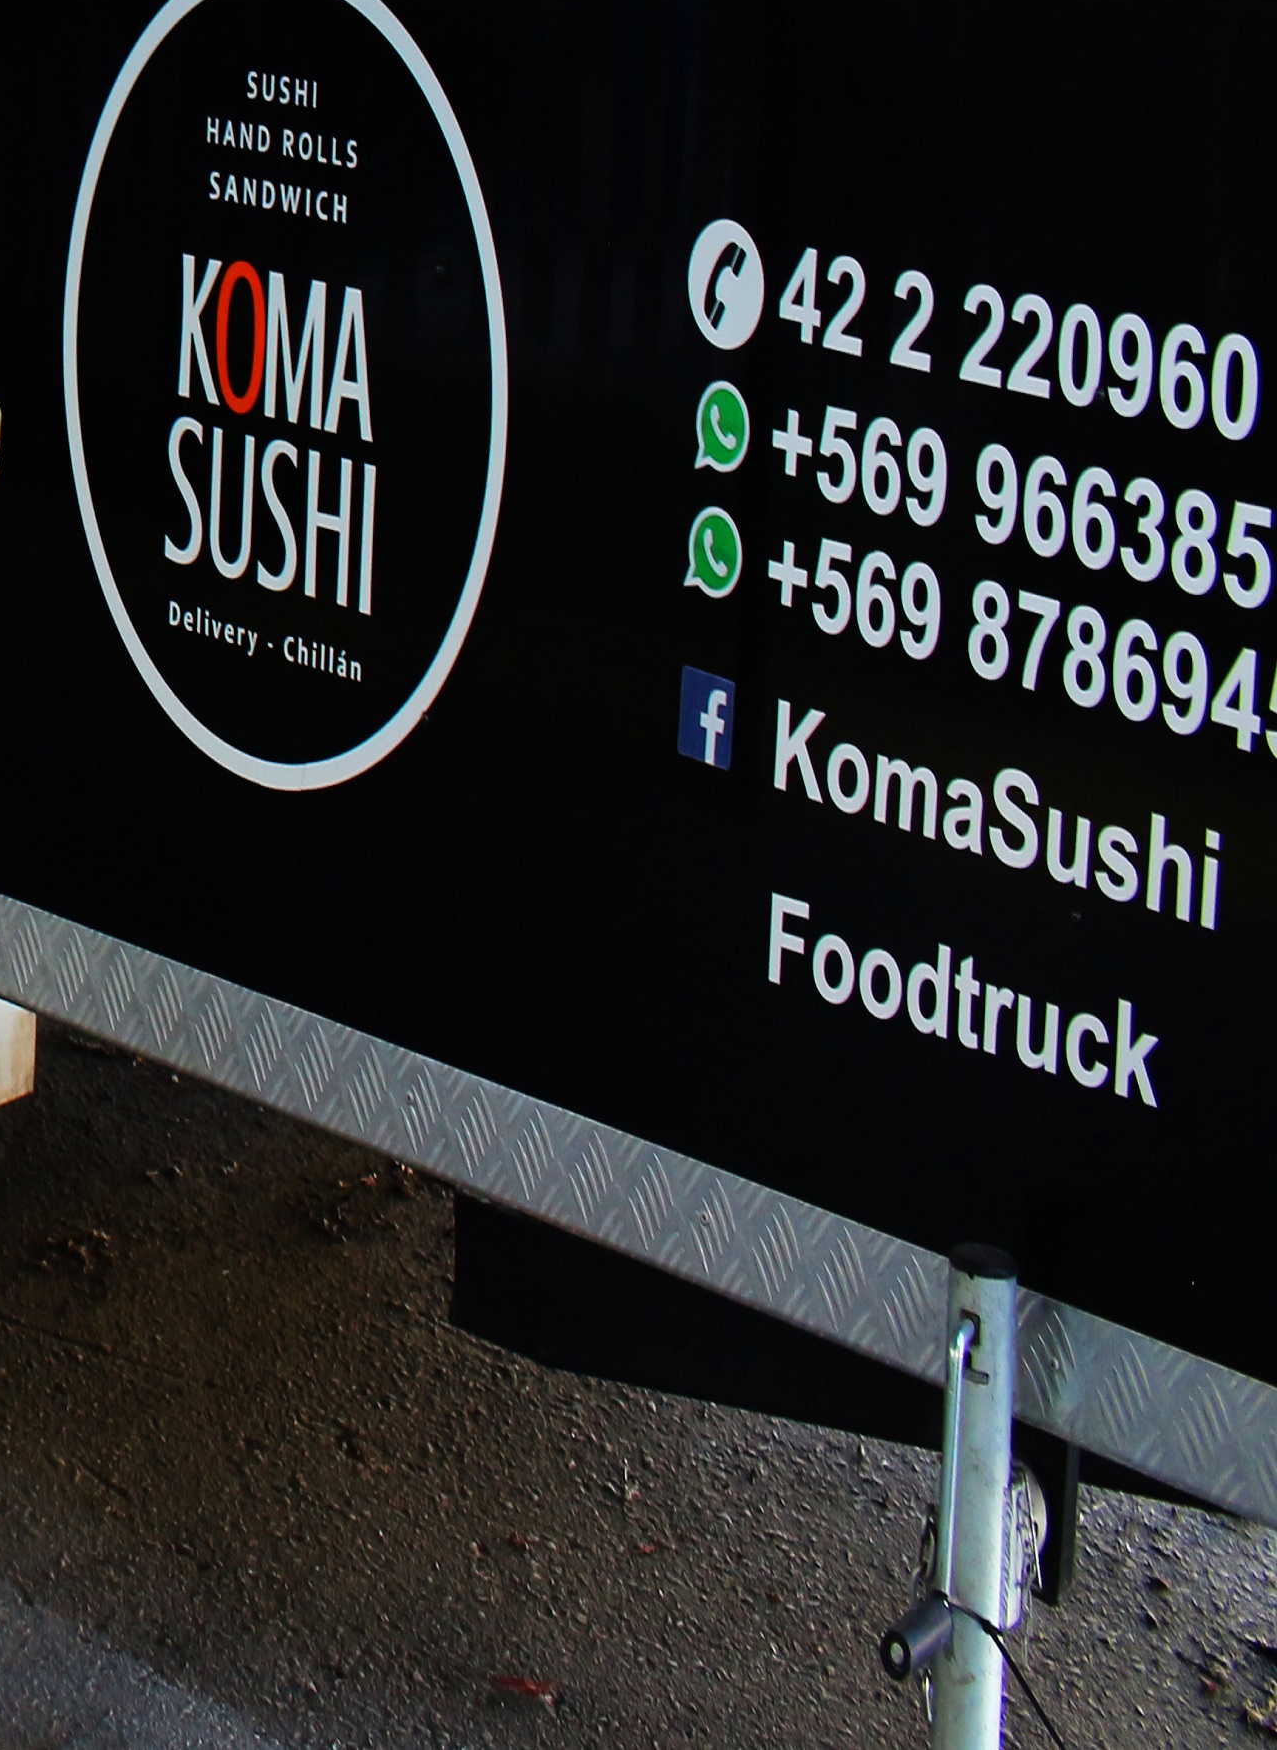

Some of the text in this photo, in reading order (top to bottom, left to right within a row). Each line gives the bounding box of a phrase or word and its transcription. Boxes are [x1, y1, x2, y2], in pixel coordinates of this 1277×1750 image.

[207, 117, 357, 168] HAND ROLLS
[247, 72, 317, 108] SUSHI
[210, 172, 347, 223] SANDWICH
[175, 254, 372, 445] KOMA
[780, 248, 1258, 440] 42 2 220960
[165, 414, 376, 618] SUSHI
[769, 539, 940, 659] +569
[773, 406, 1271, 611] +569 966385
[170, 601, 257, 656] Delivery
[284, 637, 361, 681] Chillán
[771, 696, 1224, 933] KomaSushi
[769, 890, 1160, 1107] Foodtruck
